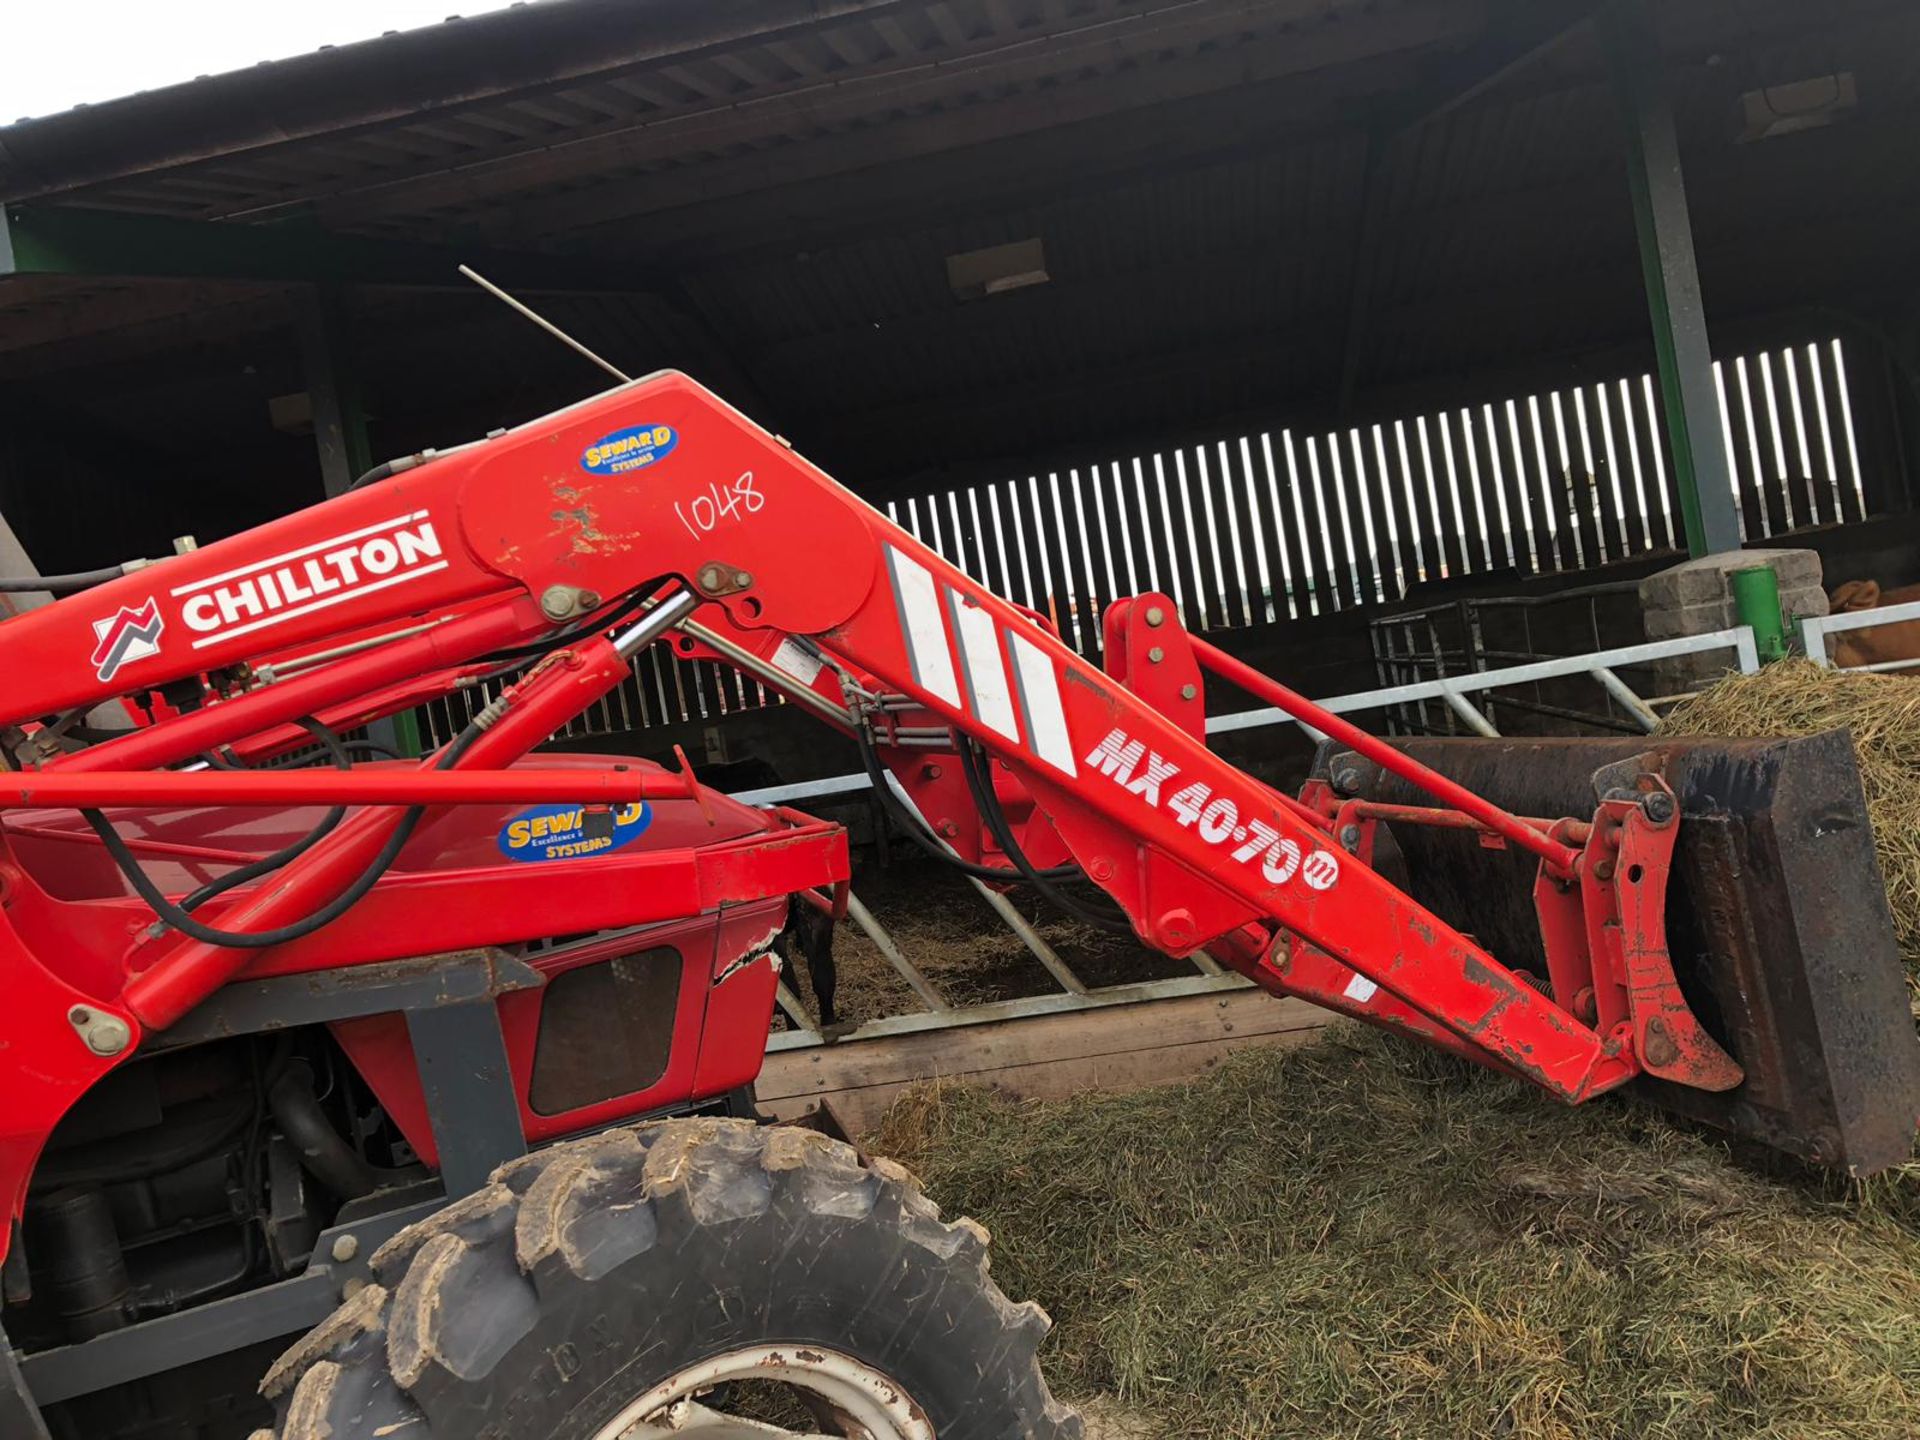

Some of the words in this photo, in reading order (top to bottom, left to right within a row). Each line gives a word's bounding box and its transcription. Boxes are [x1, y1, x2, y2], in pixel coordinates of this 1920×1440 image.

[585, 426, 671, 468] SEWARD
[611, 452, 654, 472] SYSTEMS
[674, 471, 764, 541] 1048
[182, 521, 443, 631] CHILLTON
[1084, 727, 1181, 808] MX
[531, 832, 576, 847] Excellence
[546, 836, 613, 858] SYSTEMS
